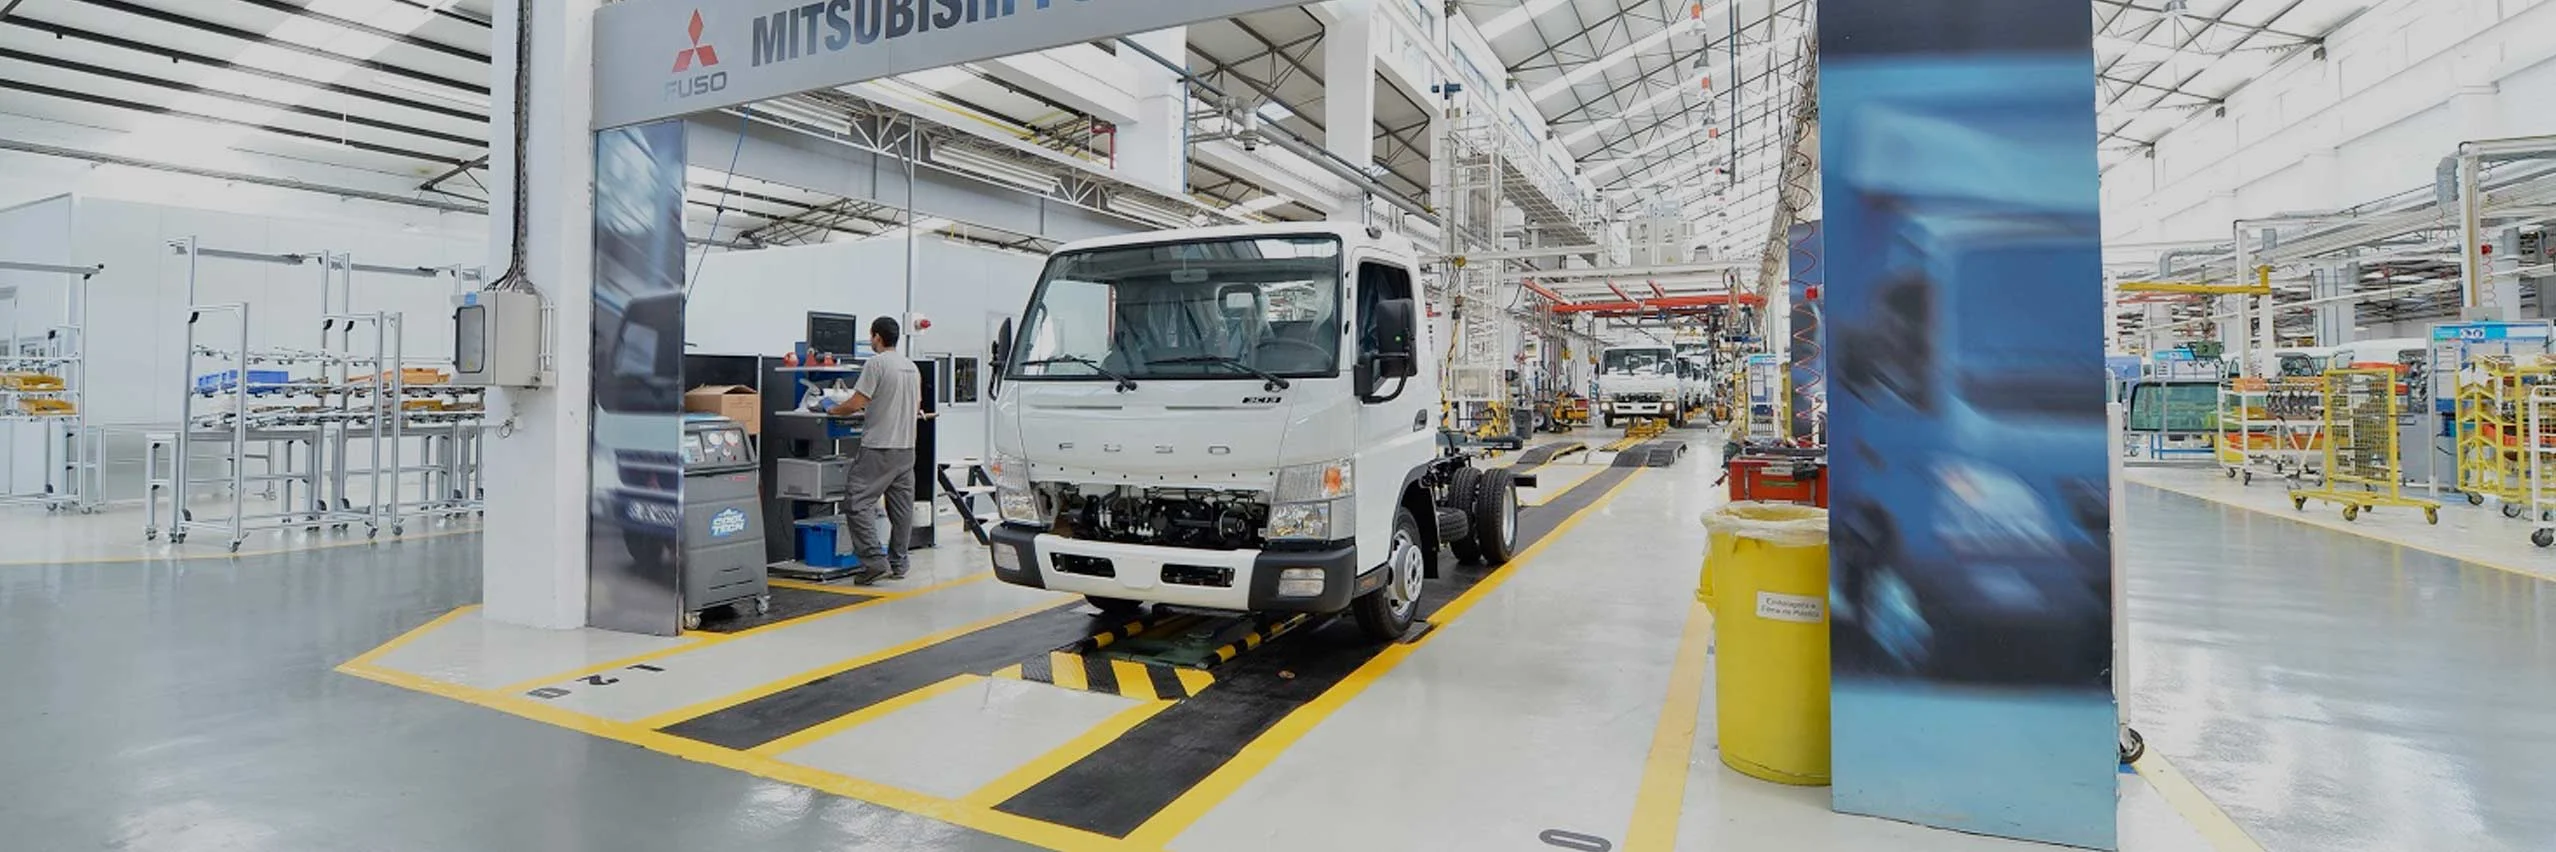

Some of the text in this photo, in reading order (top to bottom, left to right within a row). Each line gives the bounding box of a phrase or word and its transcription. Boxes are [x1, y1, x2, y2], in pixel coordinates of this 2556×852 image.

[751, 0, 1015, 67] MITSUBIS
[664, 71, 727, 100] FUSO
[1059, 442, 1231, 455] FUSO
